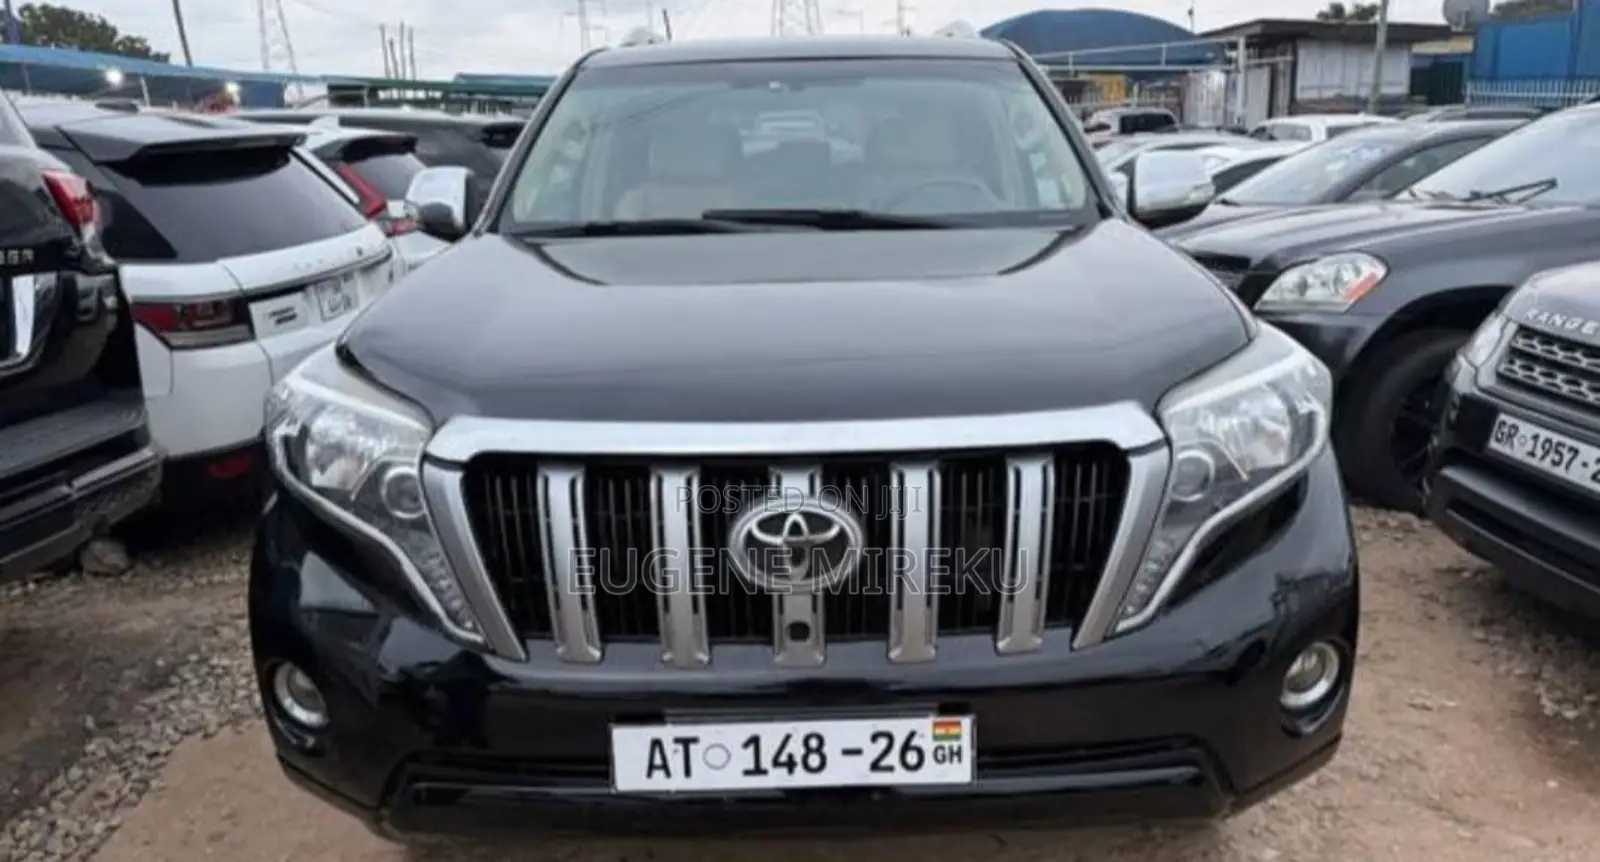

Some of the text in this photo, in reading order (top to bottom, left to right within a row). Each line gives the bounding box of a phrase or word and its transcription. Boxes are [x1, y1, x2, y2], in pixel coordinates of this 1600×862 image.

[1495, 420, 1519, 450] GR
[645, 736, 699, 778] AT
[932, 744, 963, 765] GH
